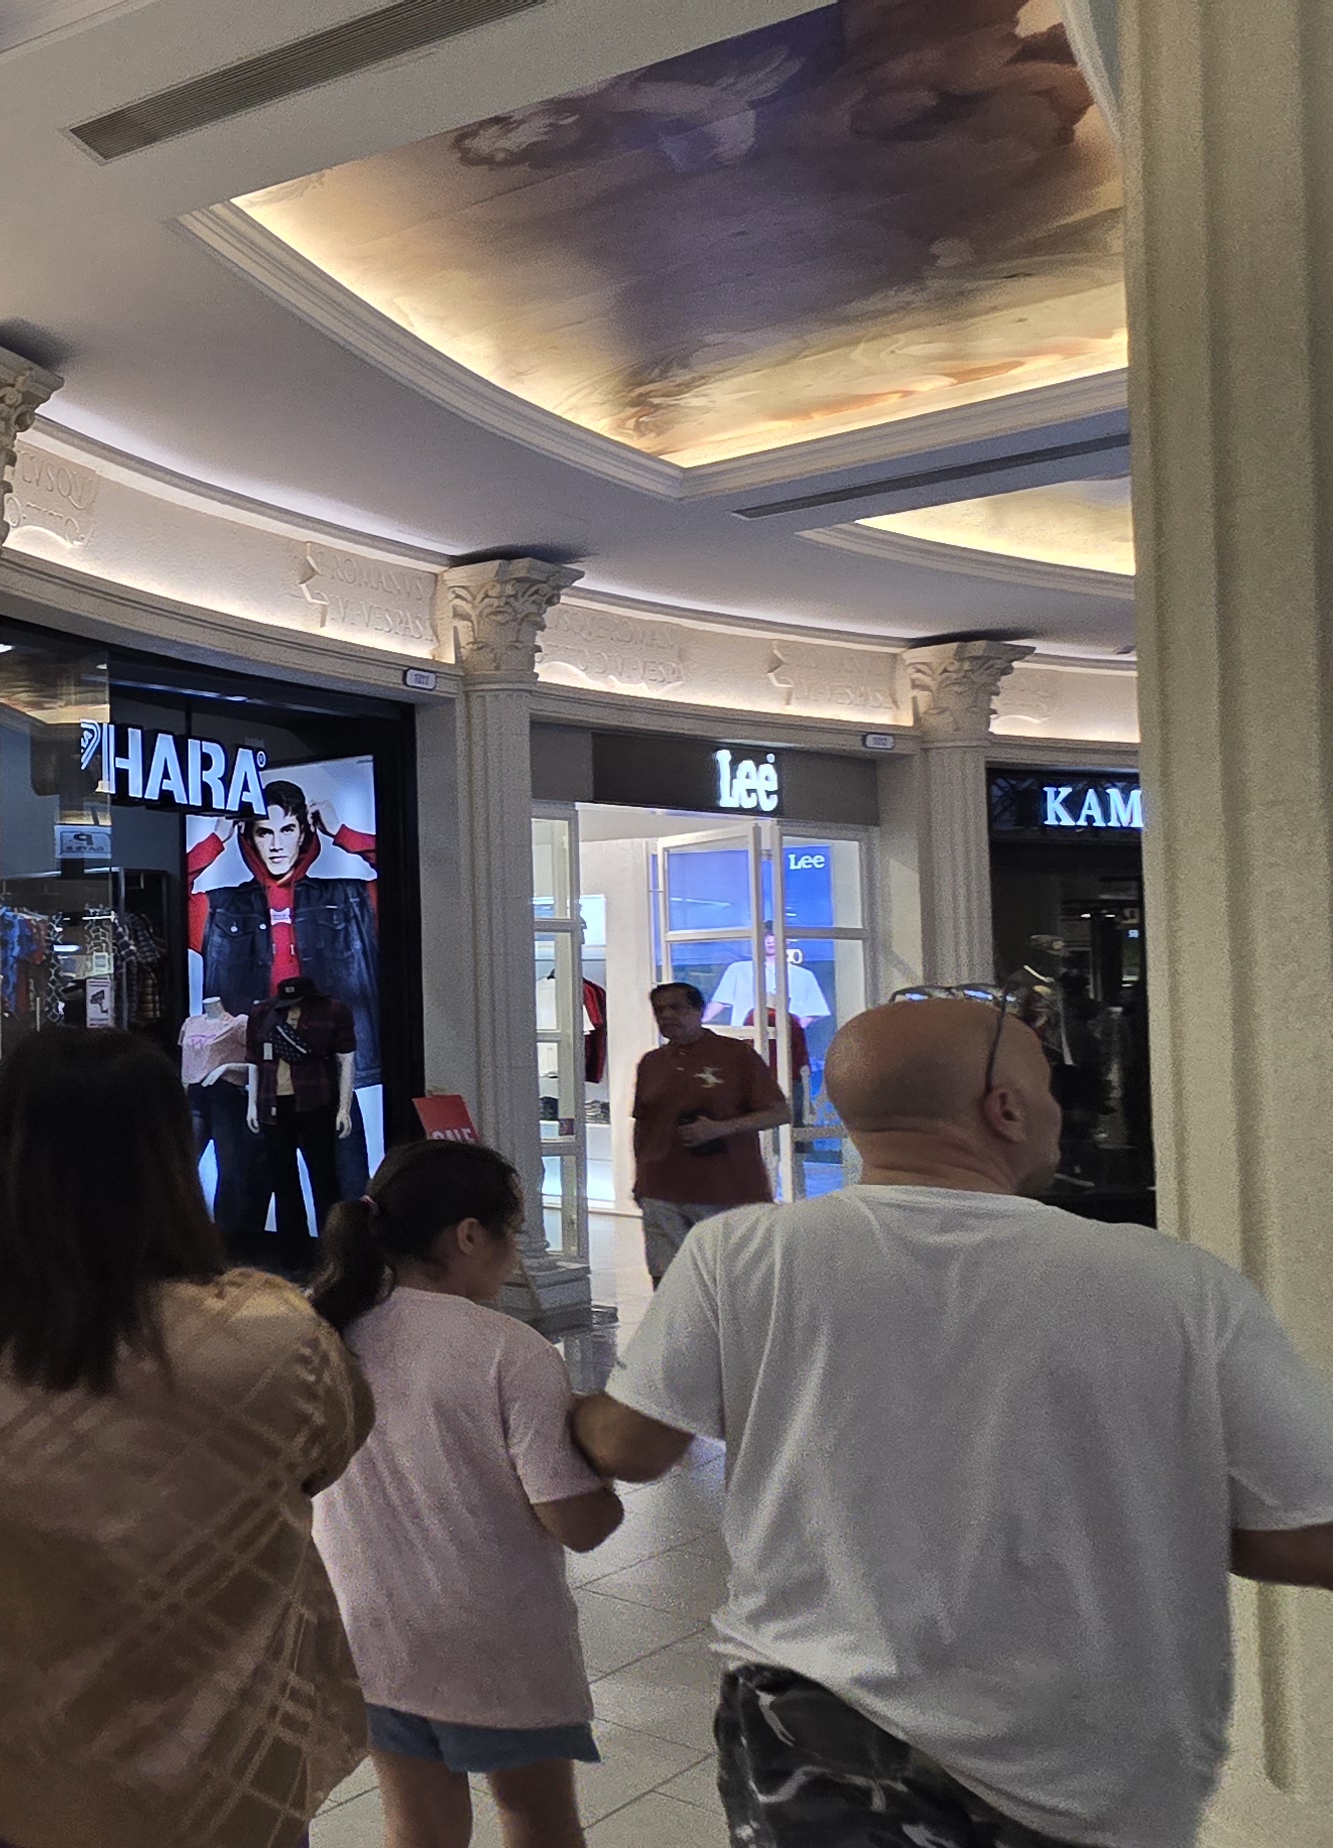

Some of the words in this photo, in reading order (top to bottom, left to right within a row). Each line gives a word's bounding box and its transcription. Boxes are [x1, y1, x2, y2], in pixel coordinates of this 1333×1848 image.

[715, 749, 779, 812] Lee
[1042, 786, 1144, 828] KAM
[787, 853, 826, 871] Lee
